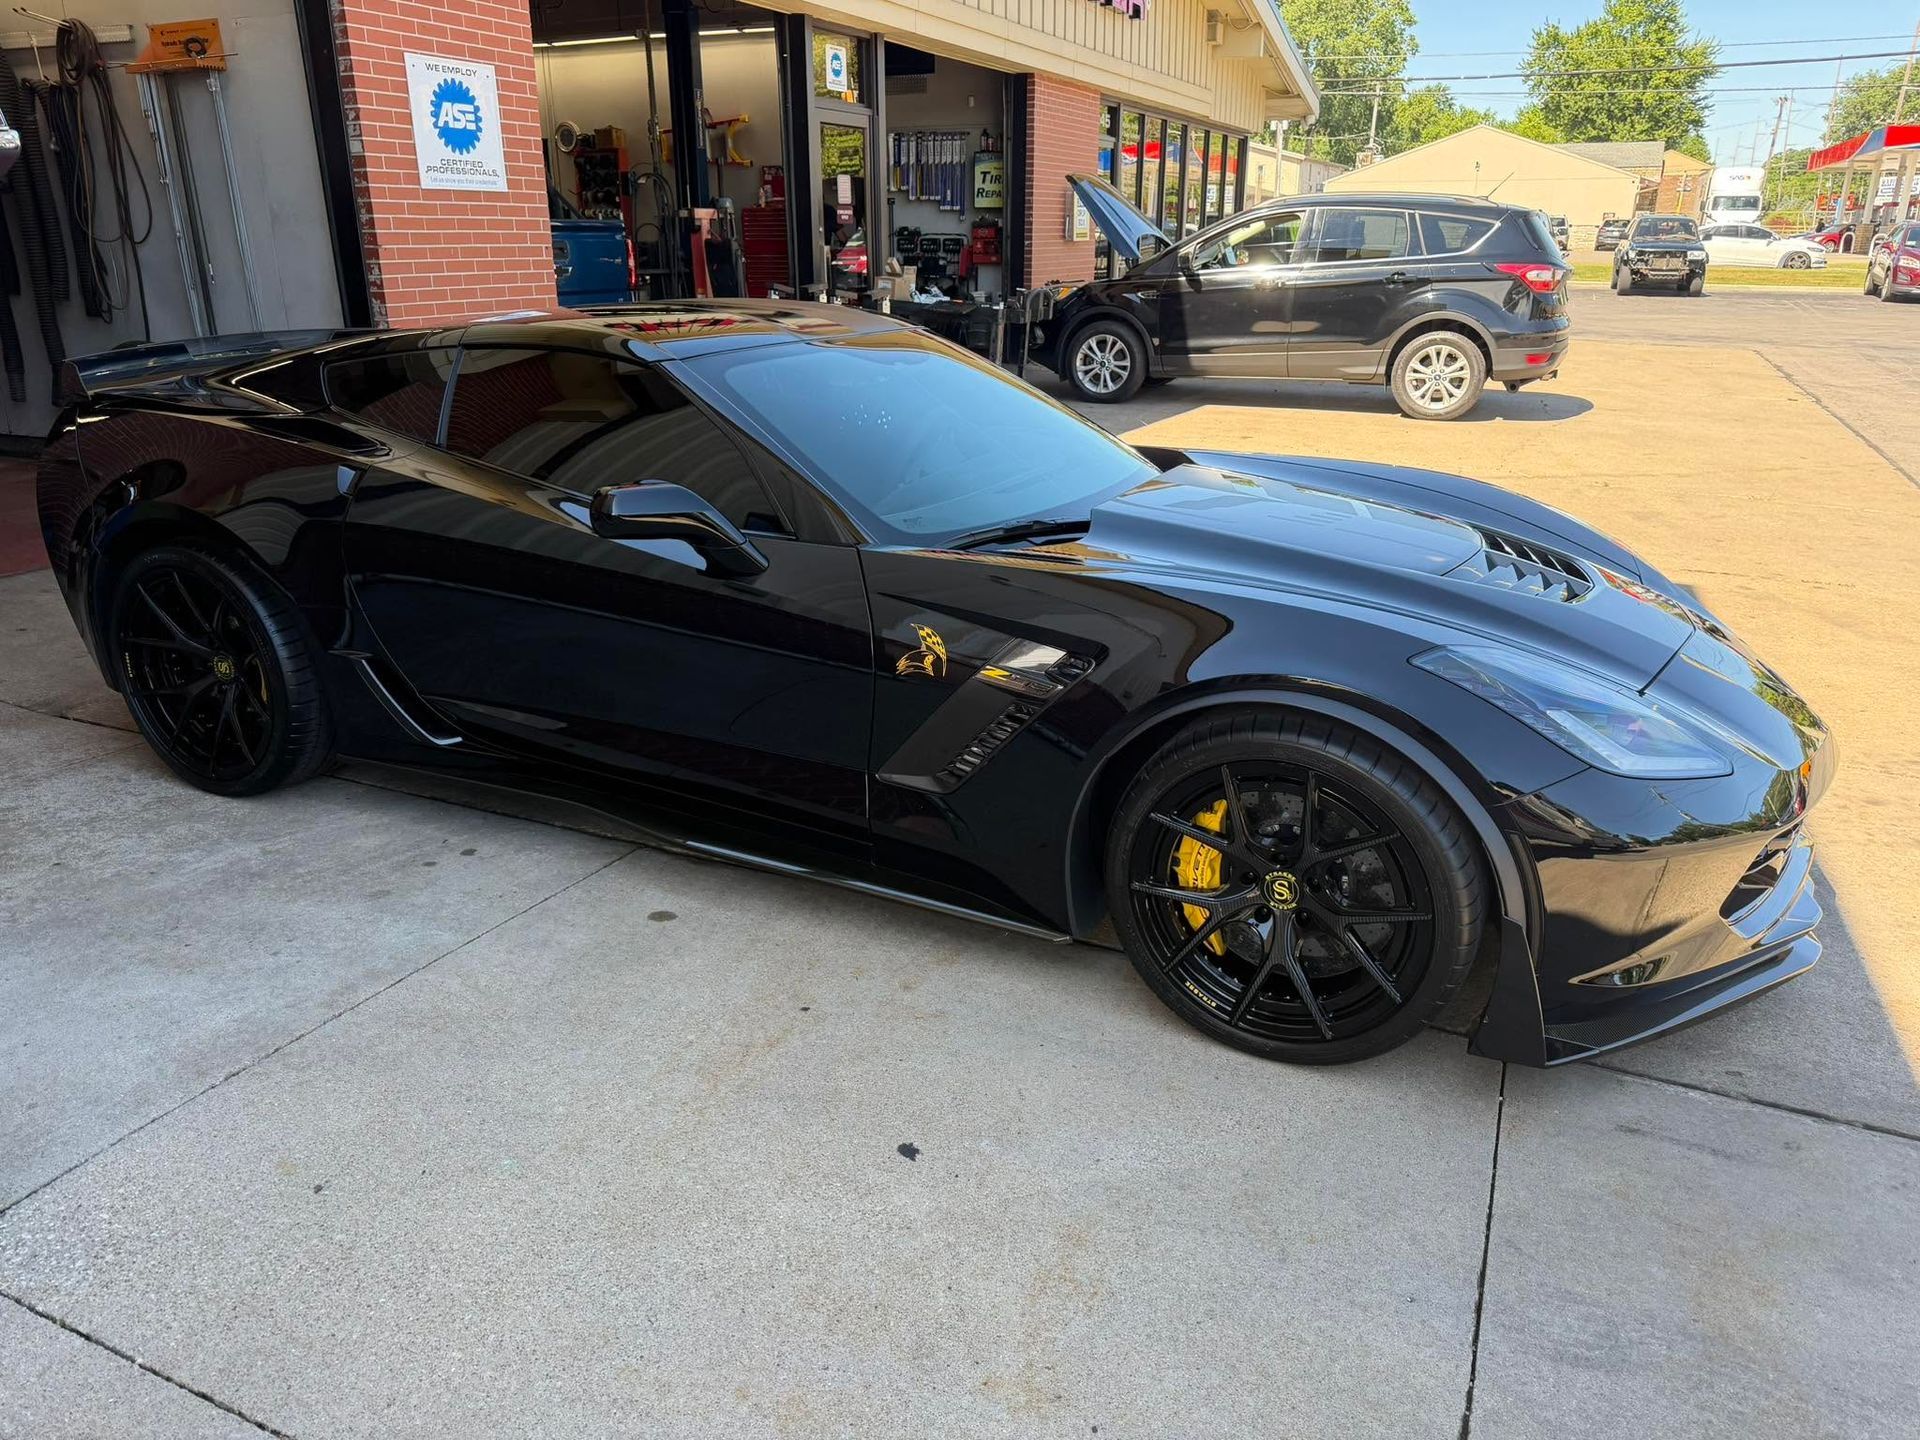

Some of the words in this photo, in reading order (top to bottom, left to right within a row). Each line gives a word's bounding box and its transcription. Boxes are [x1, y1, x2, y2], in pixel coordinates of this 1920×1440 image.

[425, 62, 440, 73] WE
[442, 64, 478, 78] EMPLOY
[437, 101, 477, 131] ASE
[440, 158, 484, 169] CERTIFIED
[426, 165, 499, 178] PROFESSIONALS
[980, 171, 1003, 185] TIR
[976, 187, 1002, 198] REPA
